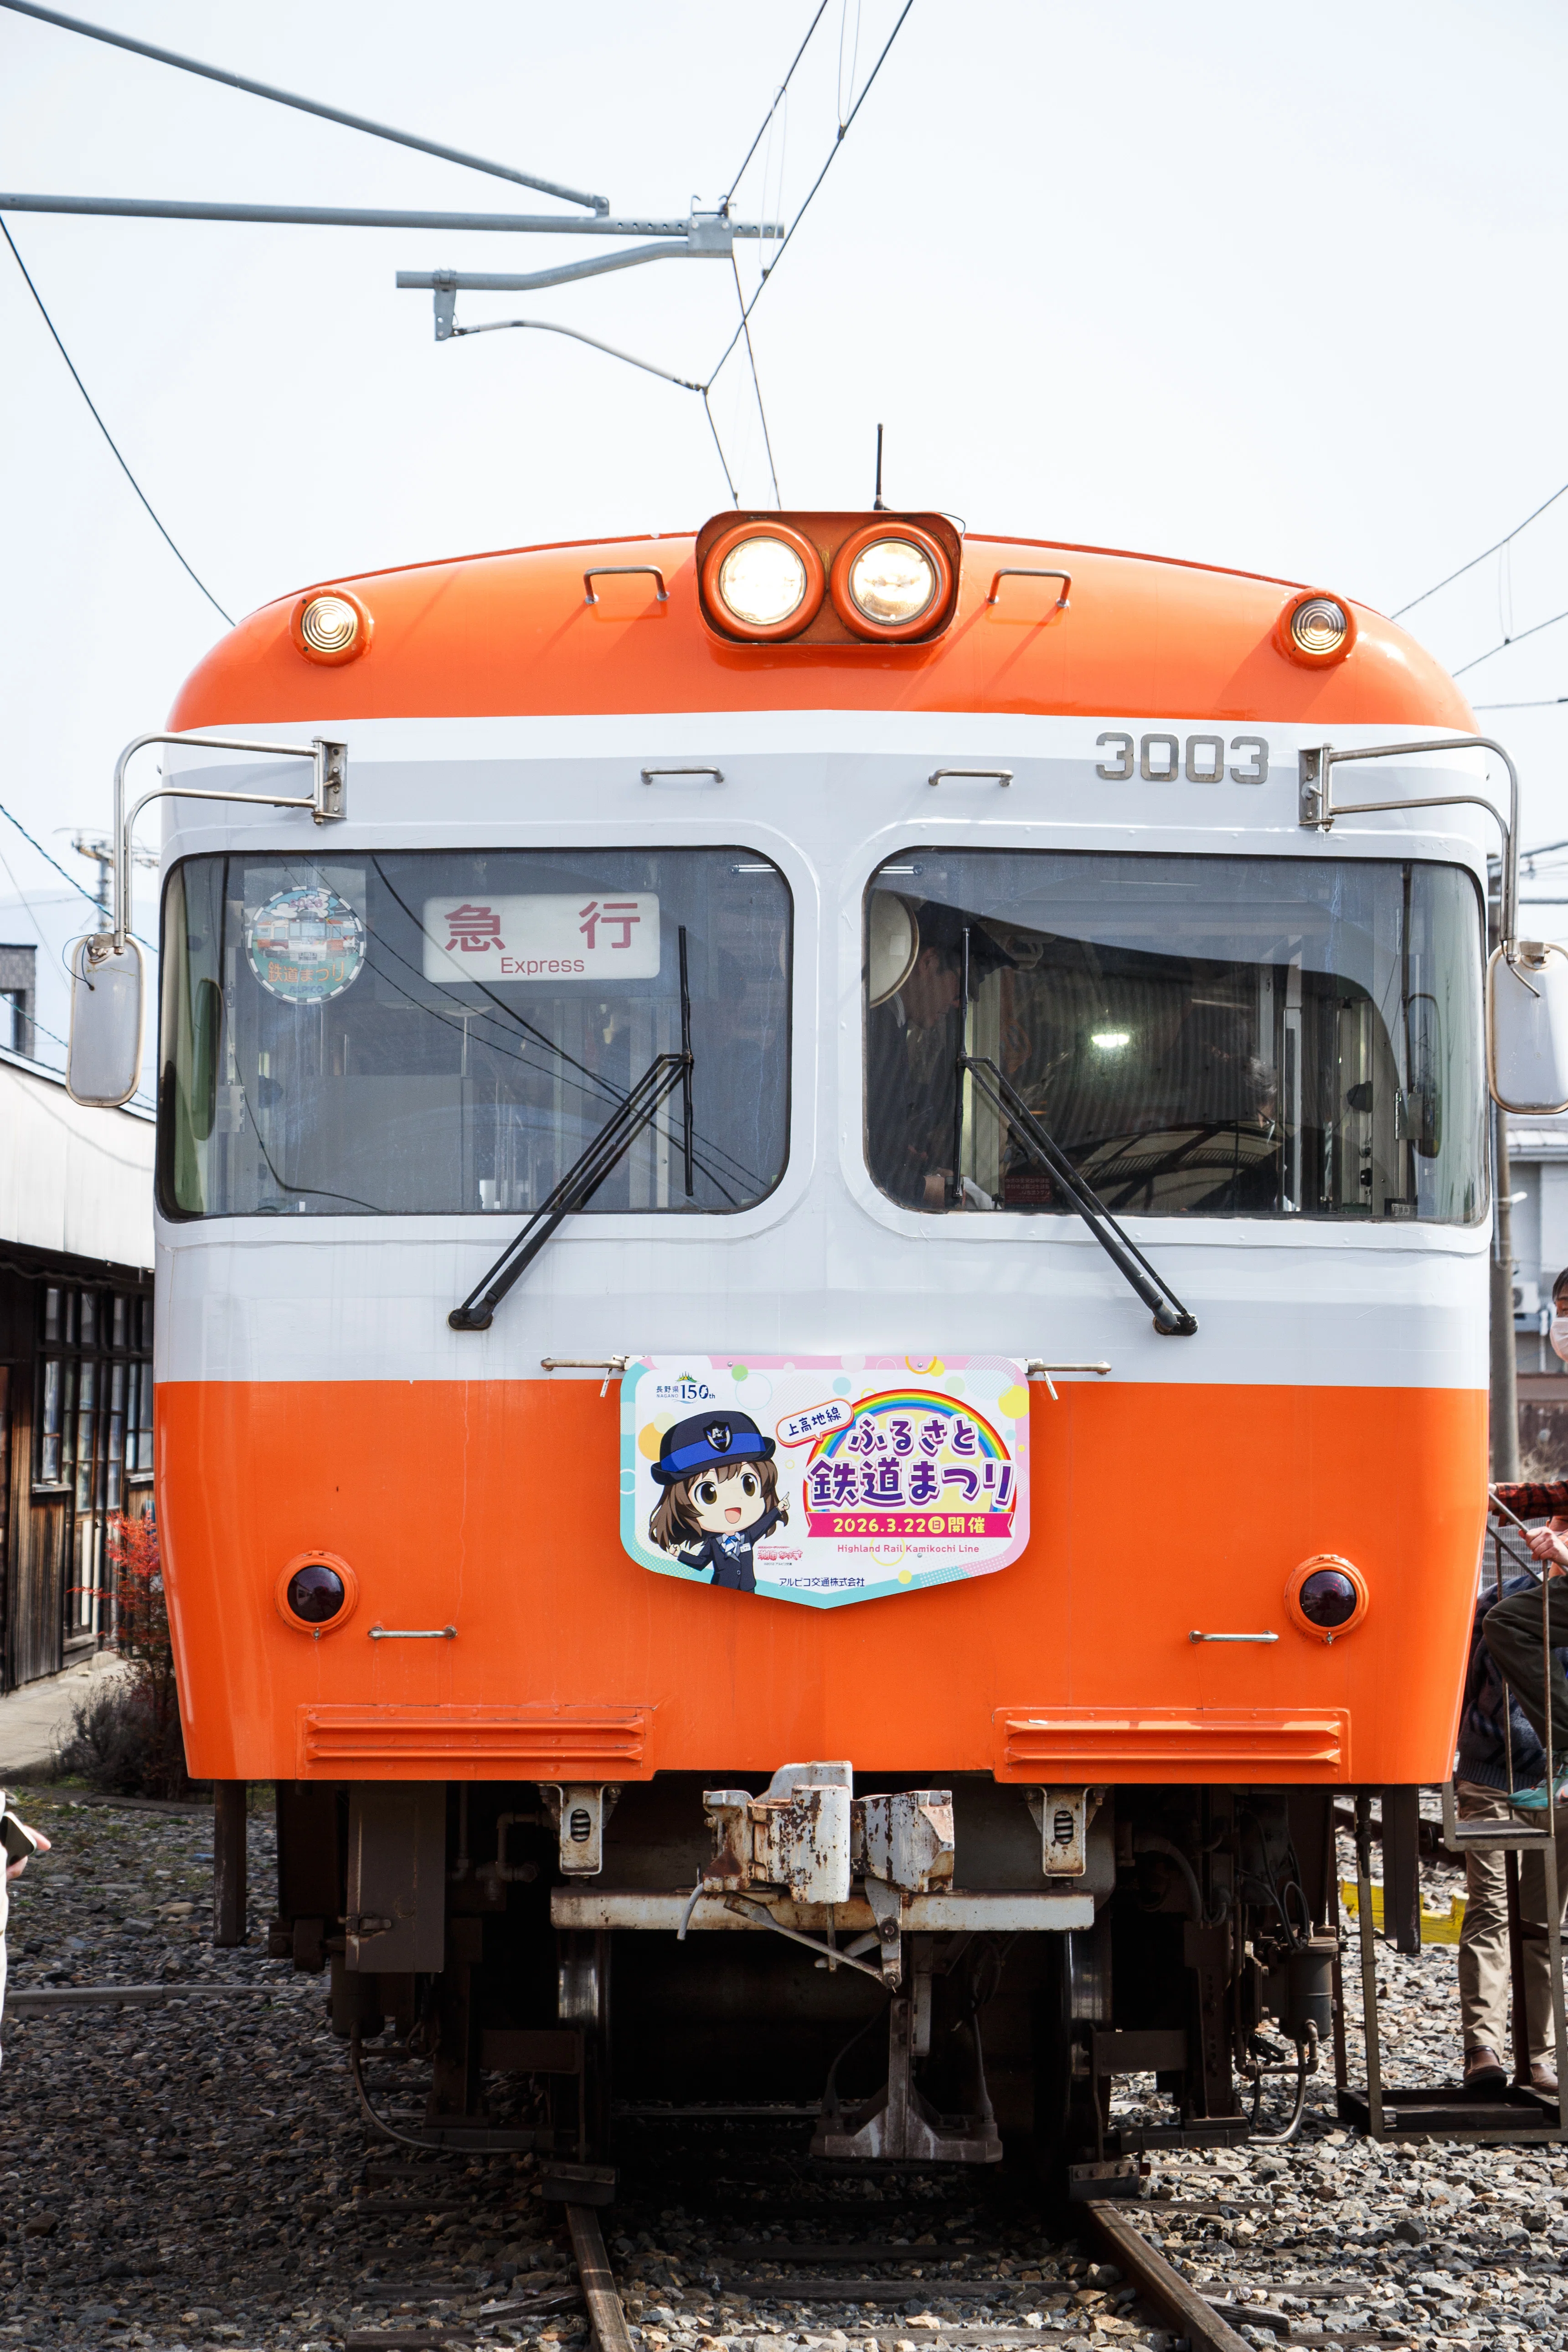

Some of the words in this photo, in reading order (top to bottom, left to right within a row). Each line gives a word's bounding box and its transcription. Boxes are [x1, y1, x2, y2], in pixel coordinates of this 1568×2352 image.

[1096, 732, 1269, 784] 3003
[268, 961, 345, 983] 鉄道まつり
[501, 957, 585, 975] Express
[789, 1406, 842, 1437] 上高地線
[849, 1419, 975, 1455] ふるさと
[809, 1456, 1011, 1505] 鉄道まつり
[837, 1545, 880, 1553] Highland
[779, 1577, 865, 1587] アルピコ交通株式会社
